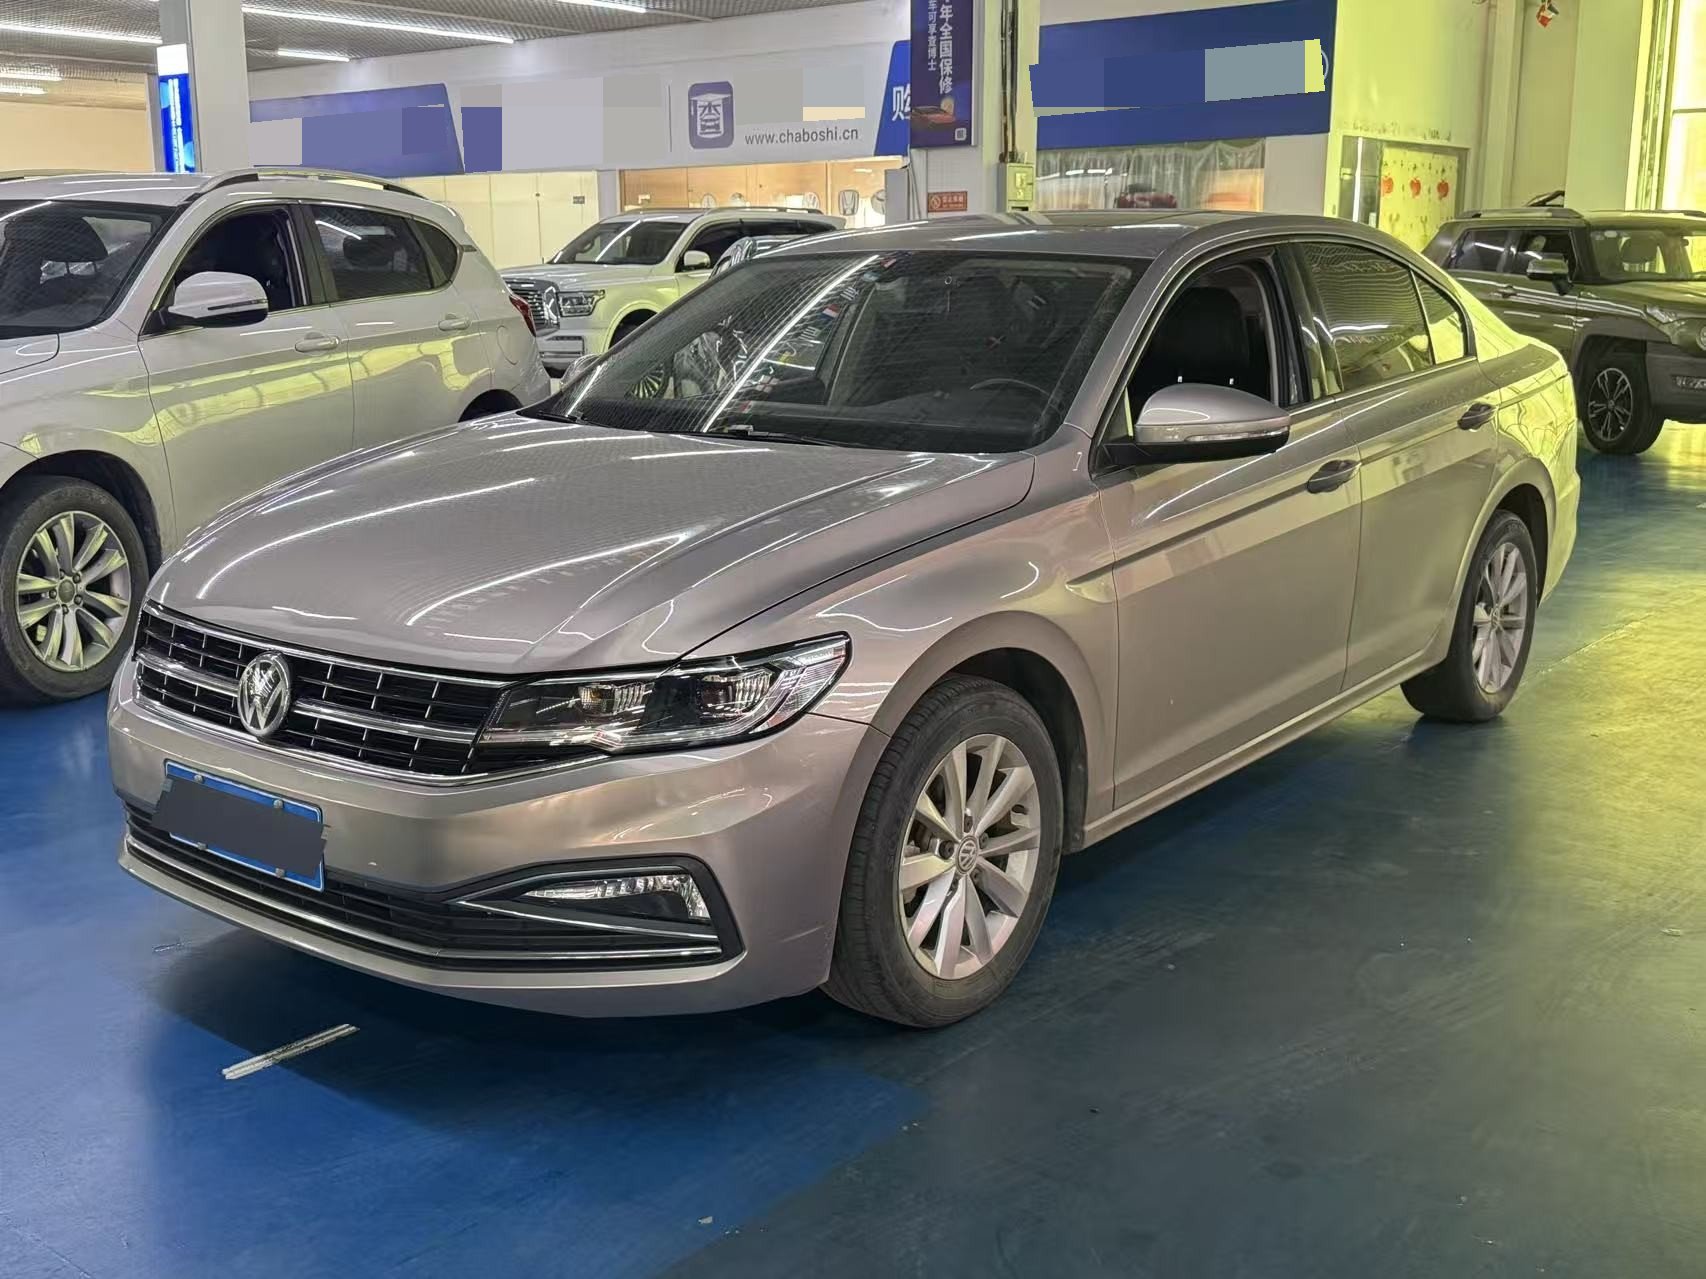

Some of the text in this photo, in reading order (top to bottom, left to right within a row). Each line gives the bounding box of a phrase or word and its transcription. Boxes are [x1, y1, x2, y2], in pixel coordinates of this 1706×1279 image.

[939, 0, 954, 94] 年全国保修
[744, 126, 859, 145] www.chaboshi.cn
